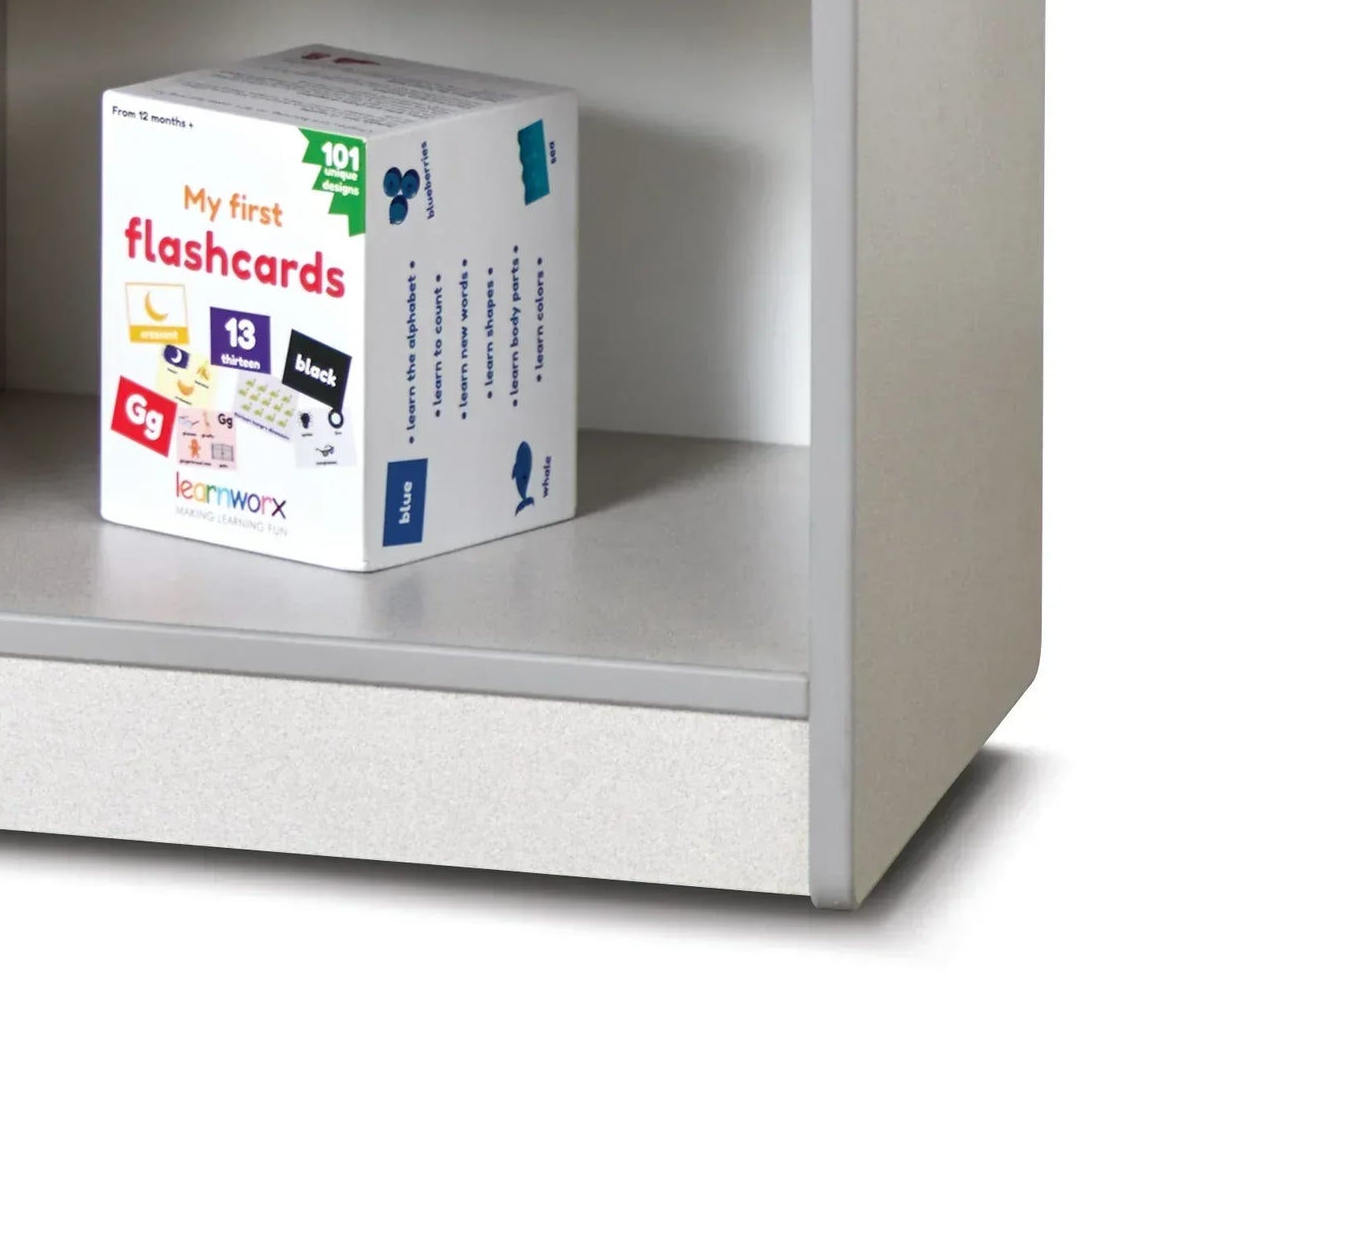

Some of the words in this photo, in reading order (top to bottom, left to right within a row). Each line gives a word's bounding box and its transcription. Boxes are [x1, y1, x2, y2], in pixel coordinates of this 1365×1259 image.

[112, 106, 136, 119] From
[138, 110, 149, 122] 12
[151, 114, 187, 129] months
[321, 141, 360, 172] 101
[548, 140, 557, 165] sea
[321, 179, 360, 197] designs
[324, 167, 359, 183] unique
[420, 141, 435, 220] blueberries
[183, 184, 222, 222] My
[229, 193, 283, 228] first
[124, 216, 346, 299] flashcards
[510, 257, 522, 302] parts
[406, 275, 419, 349] alphabet
[434, 286, 443, 335] count
[459, 271, 469, 322] words
[484, 280, 496, 338] shapes
[534, 270, 544, 322] colors
[224, 317, 257, 351] 13
[434, 338, 443, 358] to
[460, 325, 469, 359] new
[509, 306, 521, 348] body
[534, 325, 544, 370] learn
[220, 353, 261, 371] thirteen
[294, 353, 337, 388] black
[406, 353, 416, 382] the
[433, 360, 443, 406] learn
[484, 341, 494, 386] learn
[509, 350, 519, 396] learn
[459, 362, 469, 408] learn
[125, 393, 164, 441] Gg
[218, 413, 233, 429] Gg
[406, 386, 416, 431] learn
[175, 470, 287, 520] learnworx
[542, 455, 552, 498] whale
[176, 505, 215, 523] MAKING
[217, 513, 265, 533] LEARNING
[267, 523, 289, 537] FUN
[398, 481, 414, 525] blue
